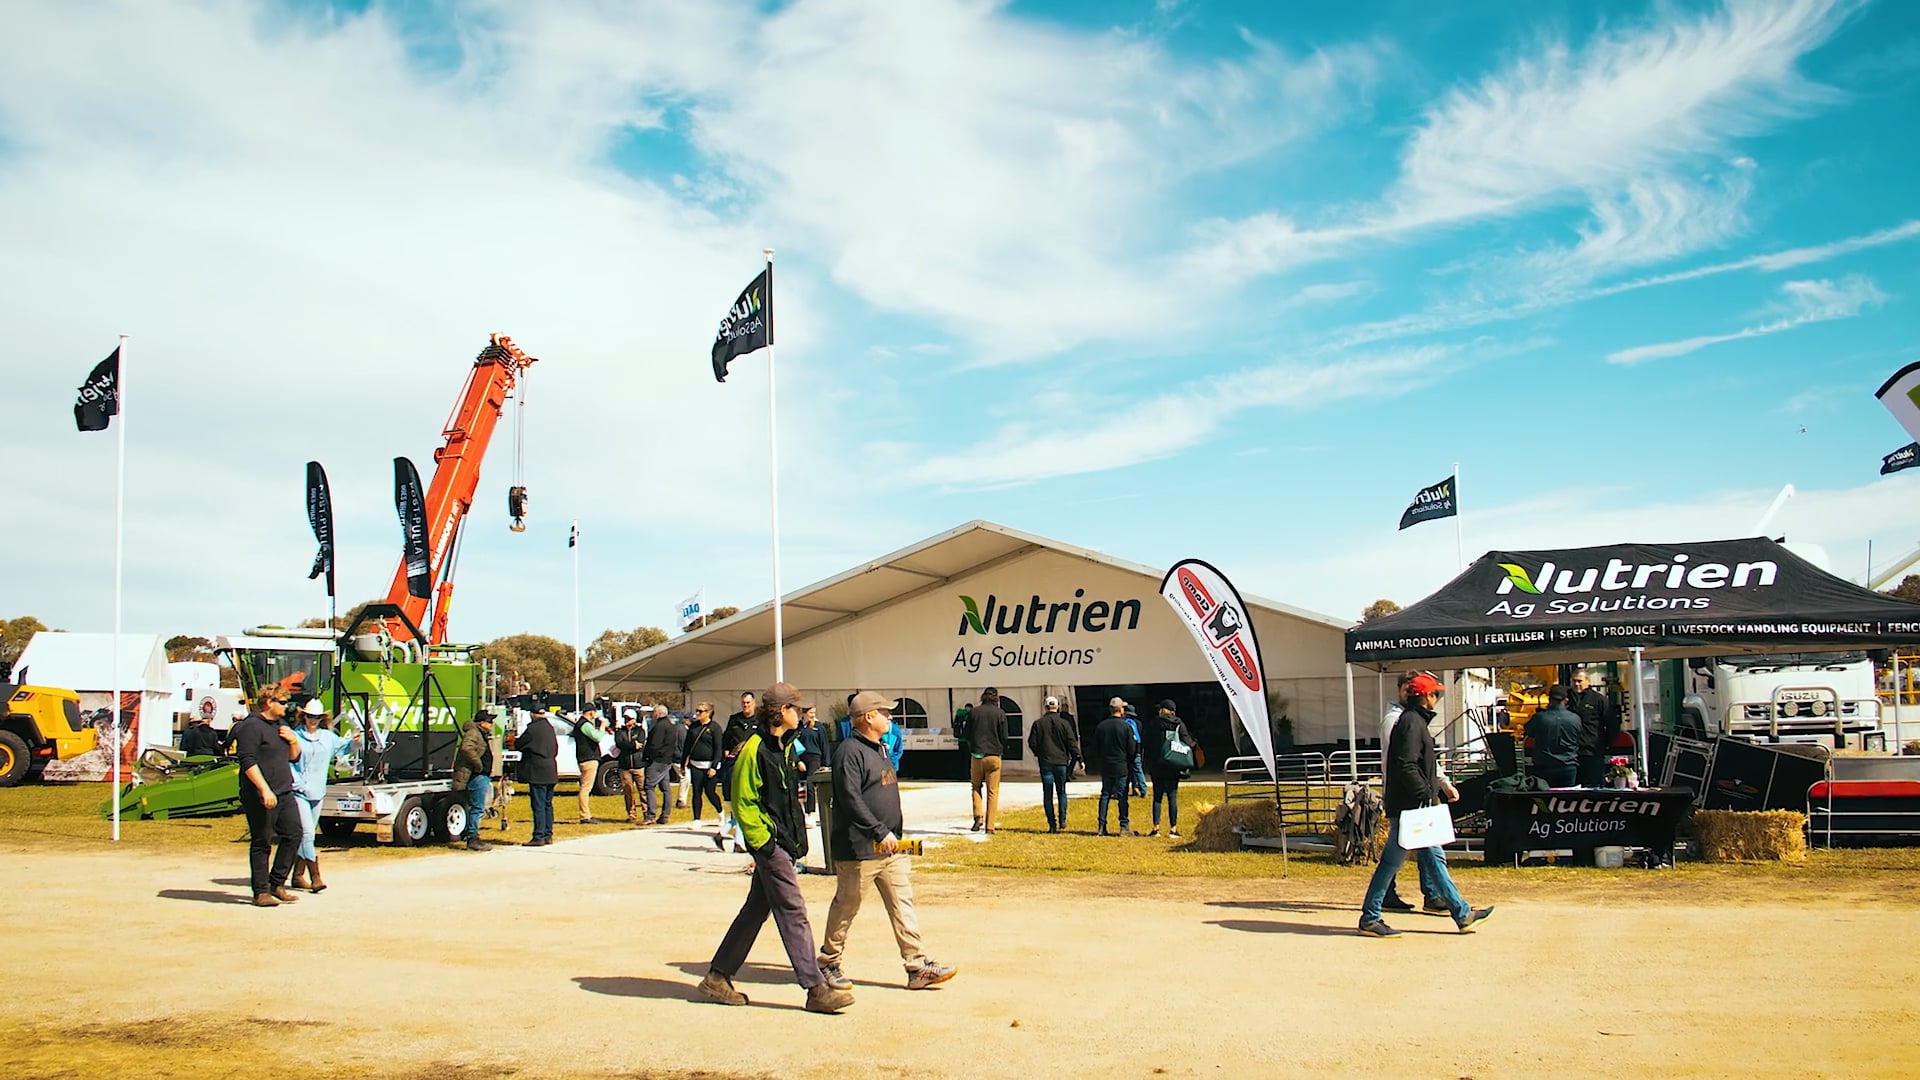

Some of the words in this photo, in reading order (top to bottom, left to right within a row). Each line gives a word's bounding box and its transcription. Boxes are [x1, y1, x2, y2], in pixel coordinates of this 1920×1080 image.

[1496, 554, 1778, 594] Nutrien
[958, 588, 1141, 635] Nutrien
[1486, 600, 1536, 618] Ag
[1545, 595, 1711, 614] Solutions
[1354, 641, 1396, 651] ANIMAL
[1399, 636, 1470, 648] PRODUCTION
[1484, 631, 1545, 643] FERTILISER
[1559, 629, 1588, 639] SEED
[1603, 625, 1656, 636] PRODUCE
[1671, 624, 1735, 634] LIVESTOCK
[1737, 623, 1799, 633] HANDLING
[1801, 623, 1871, 635] EQUIPMENT
[952, 647, 982, 673] Ag
[989, 645, 1094, 667] Solutions
[1781, 692, 1820, 700] ISUZU
[1531, 797, 1661, 816] Nutrien
[1529, 821, 1551, 838] Ag
[1555, 818, 1627, 834] Solutions
